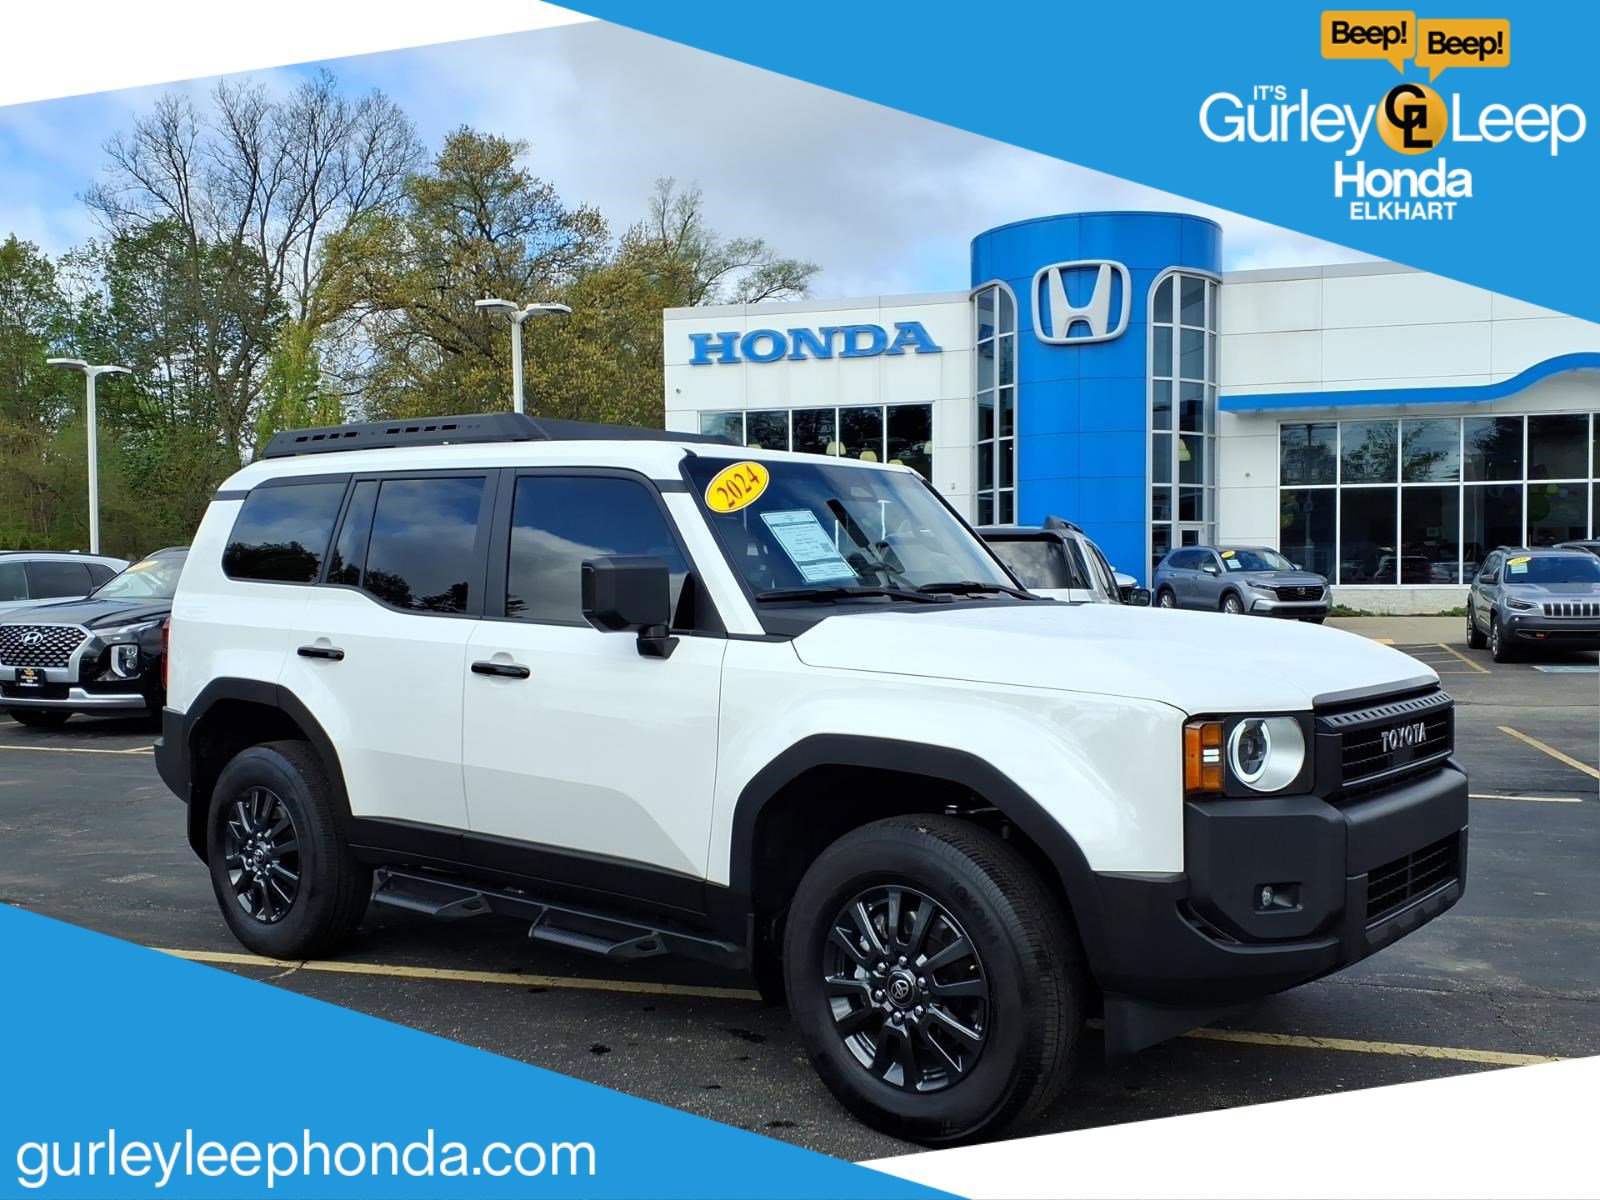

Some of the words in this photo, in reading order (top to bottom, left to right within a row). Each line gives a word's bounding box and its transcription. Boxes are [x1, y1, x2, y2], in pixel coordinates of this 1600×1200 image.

[689, 321, 941, 365] HONDA
[717, 465, 760, 507] 2024
[1381, 722, 1426, 752] TOYOTA
